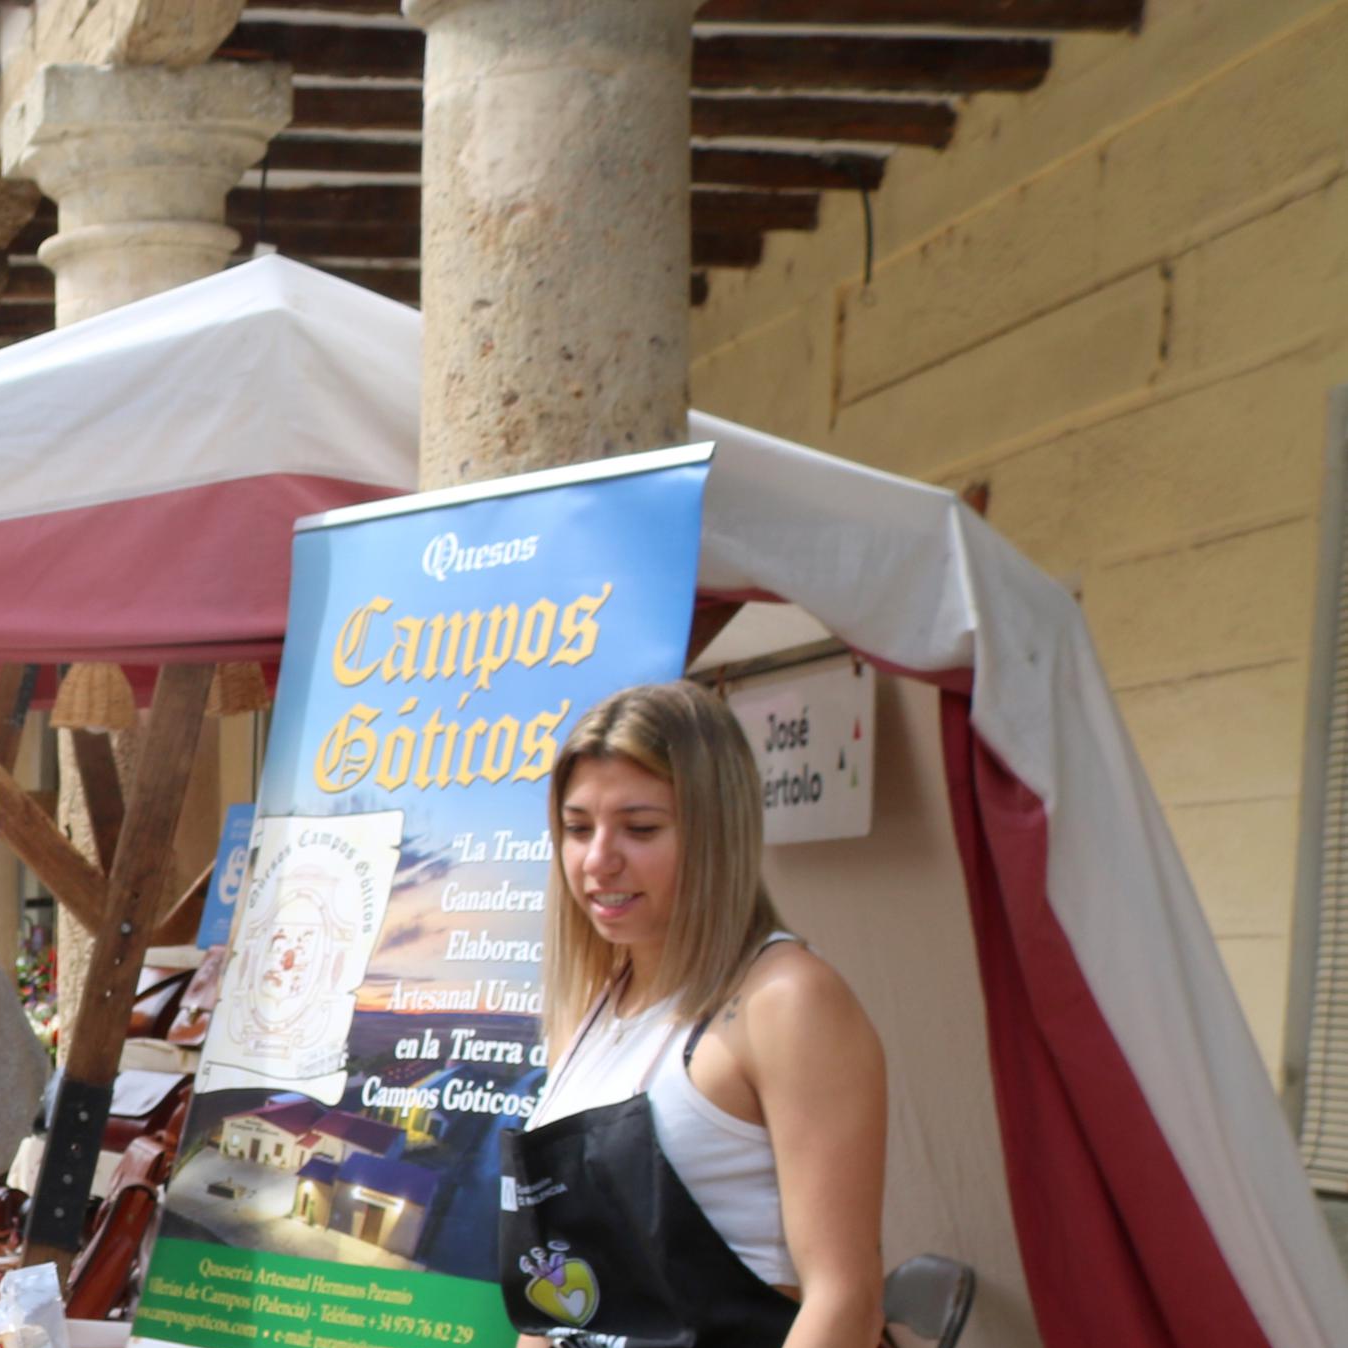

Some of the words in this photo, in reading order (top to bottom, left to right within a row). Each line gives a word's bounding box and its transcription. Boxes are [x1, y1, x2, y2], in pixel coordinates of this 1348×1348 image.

[422, 532, 539, 581] Quesos
[332, 582, 614, 691] Campos
[313, 691, 571, 794] Góticos
[765, 705, 810, 754] José
[441, 881, 545, 912] Ganadera
[385, 979, 481, 1012] Artesanal
[395, 1037, 419, 1060] en
[420, 1028, 440, 1061] la
[449, 1028, 524, 1066] Tierra
[361, 1075, 440, 1118] Campos
[255, 1267, 312, 1291] Artesanal
[311, 1276, 367, 1299] Hermanos
[452, 1324, 475, 1345] 29
